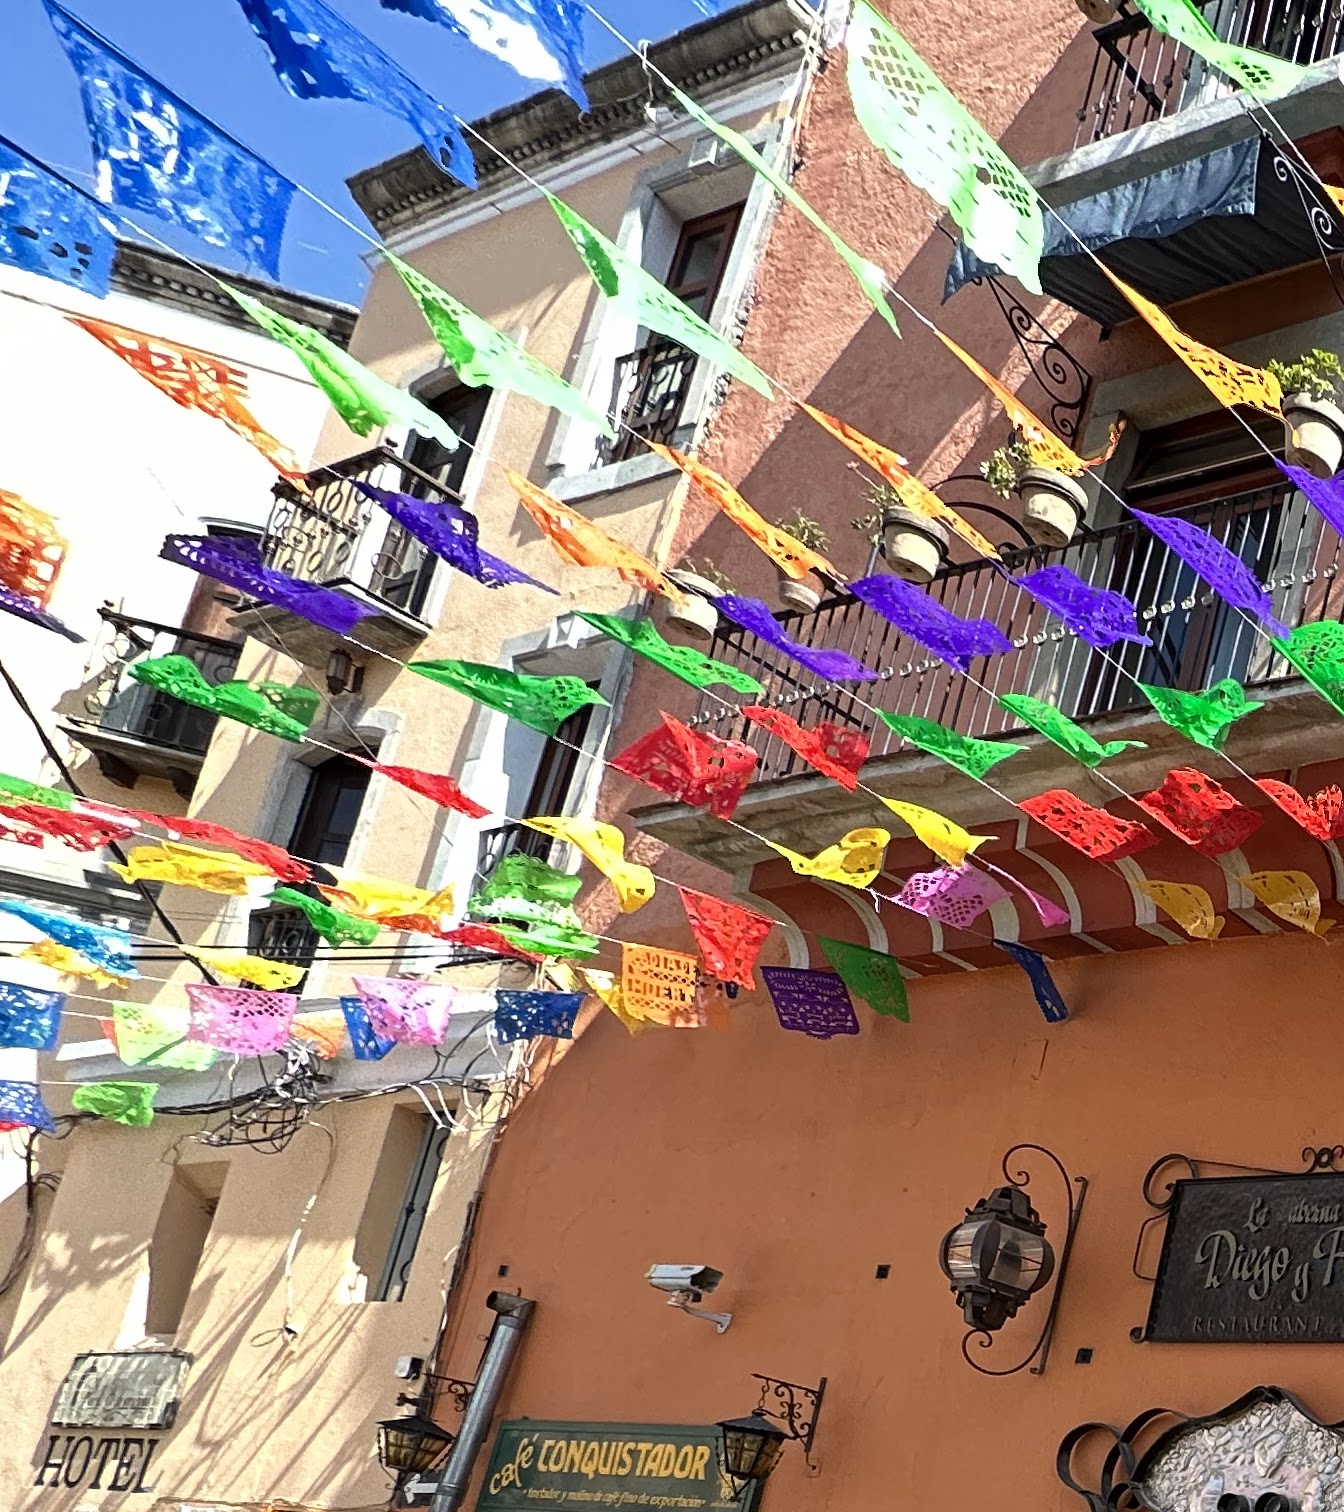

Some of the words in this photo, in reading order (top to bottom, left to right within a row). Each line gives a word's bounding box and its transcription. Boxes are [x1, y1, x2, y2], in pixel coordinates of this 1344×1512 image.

[1194, 1229, 1293, 1301] Diego
[1290, 1259, 1310, 1303] y
[34, 1434, 161, 1494] HOTEL
[537, 1438, 711, 1481] CONQUISTADOR
